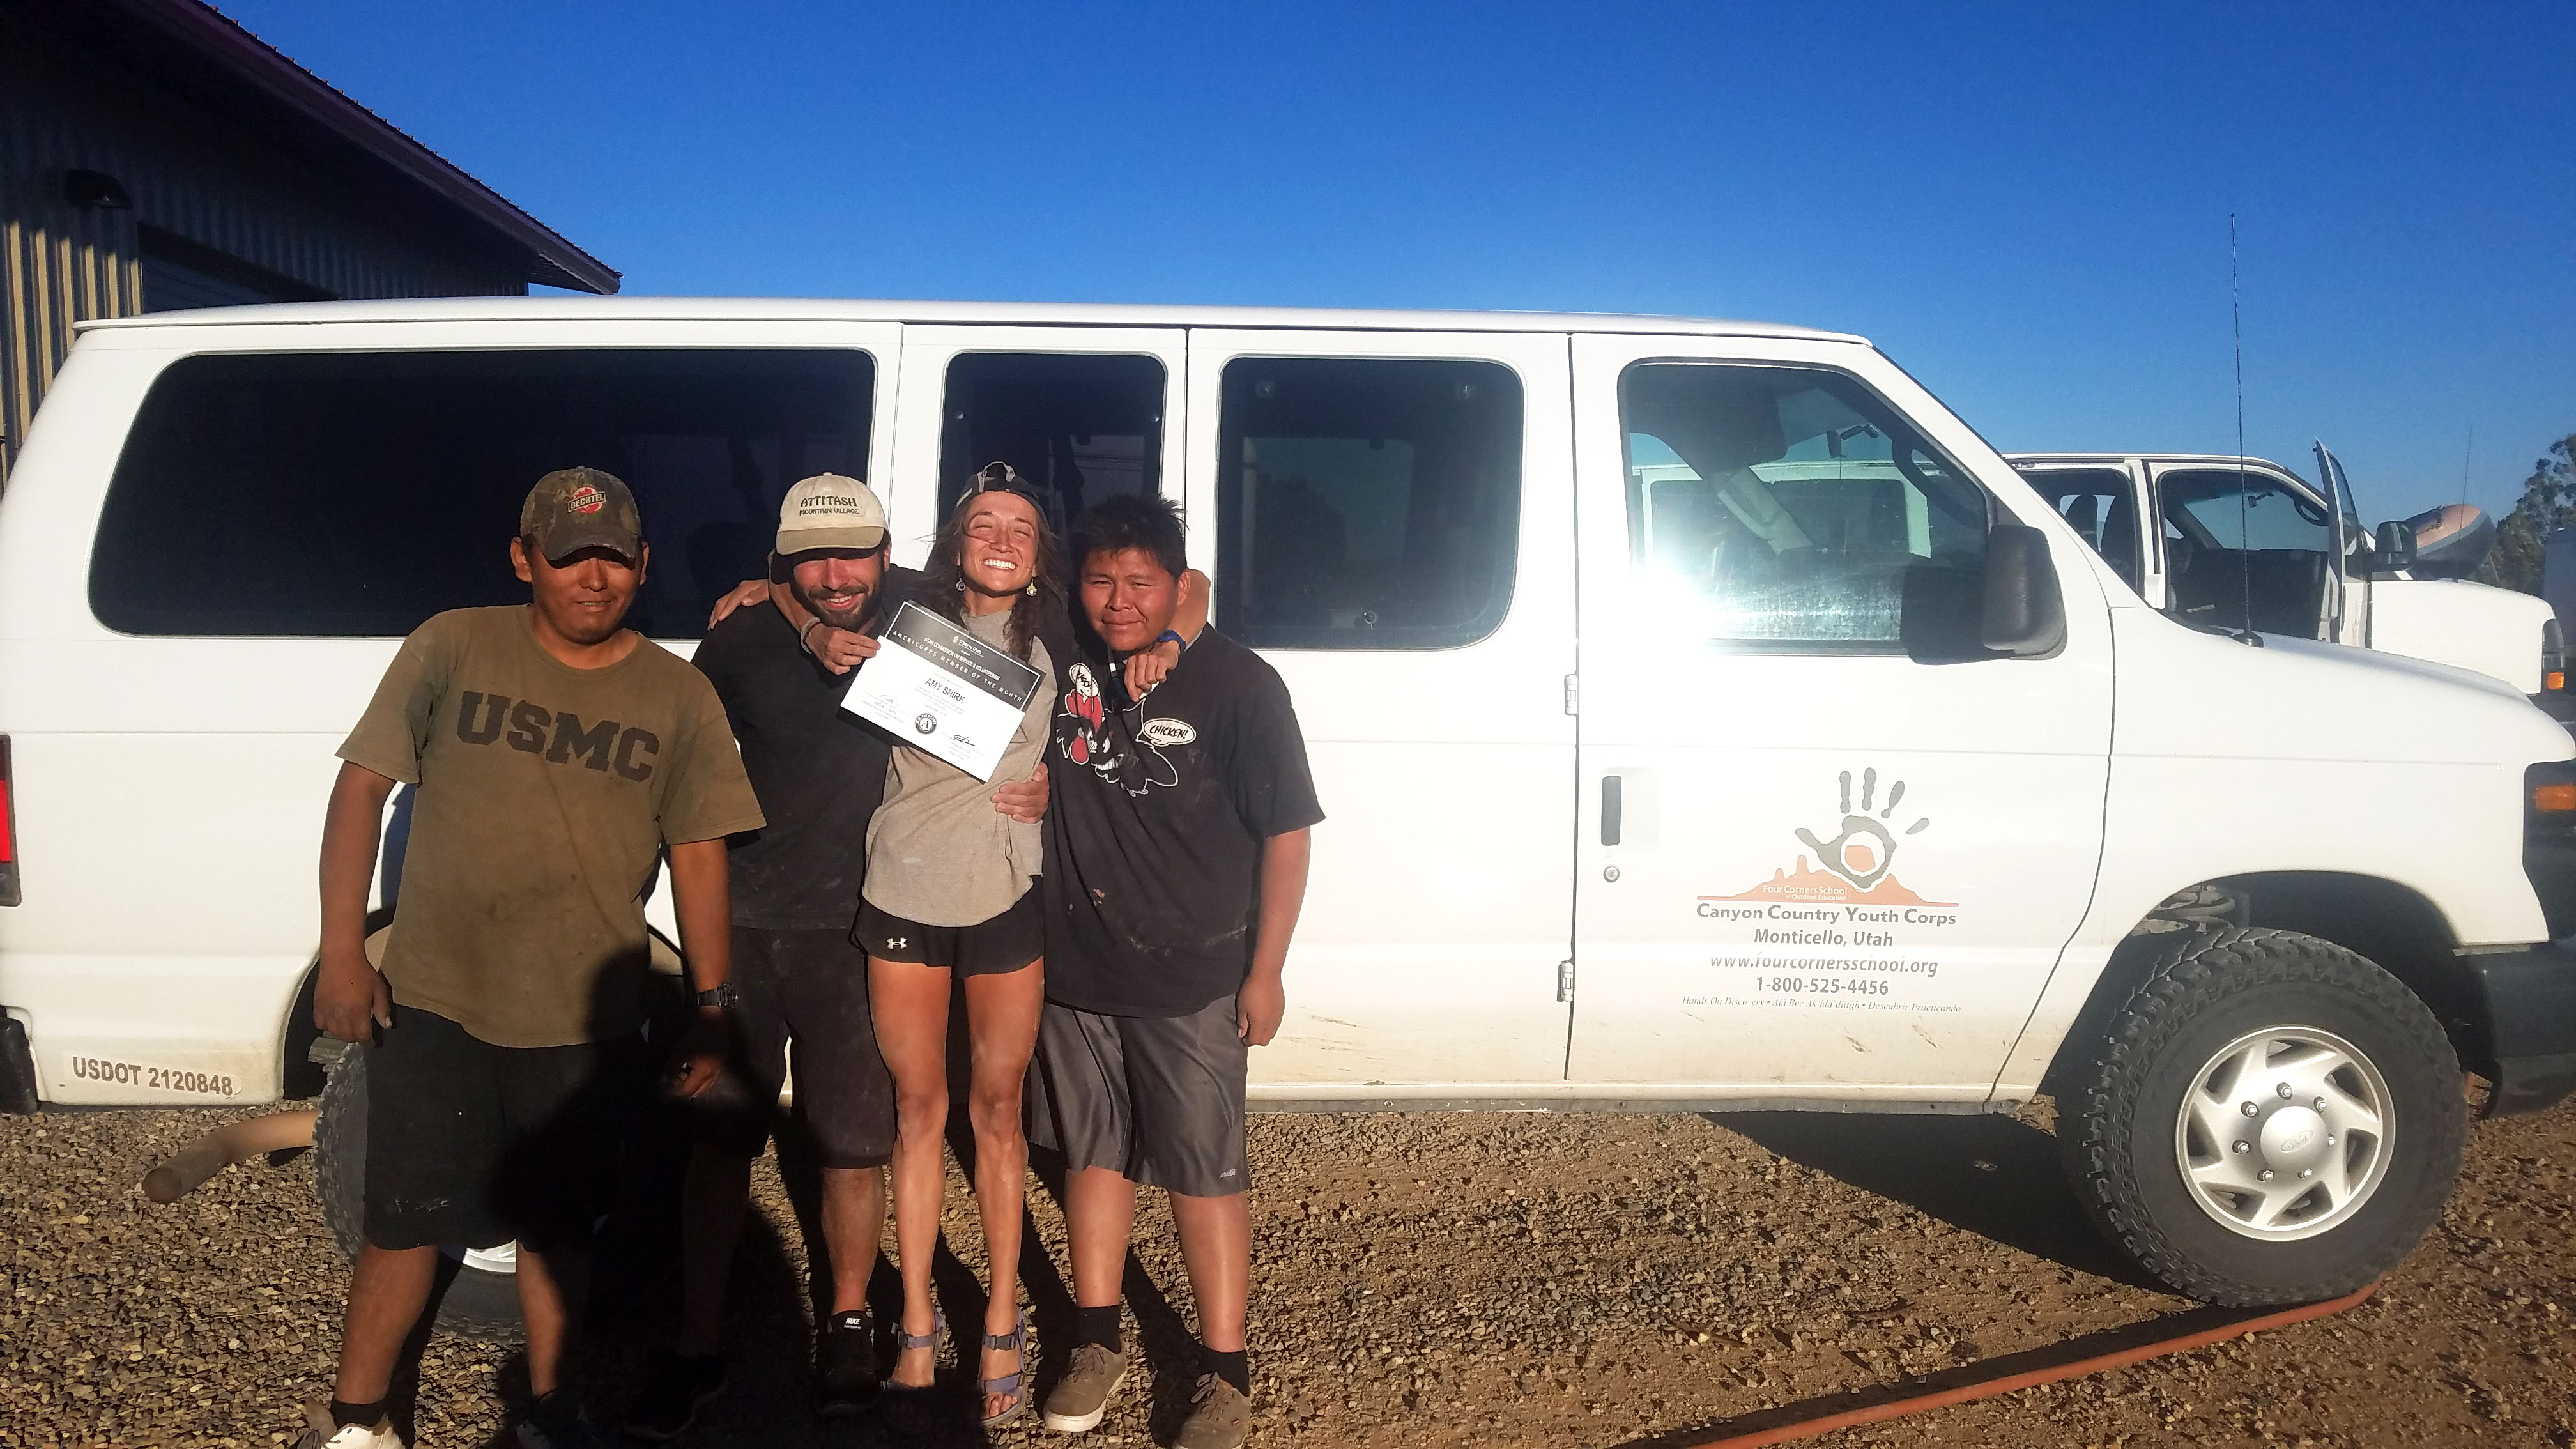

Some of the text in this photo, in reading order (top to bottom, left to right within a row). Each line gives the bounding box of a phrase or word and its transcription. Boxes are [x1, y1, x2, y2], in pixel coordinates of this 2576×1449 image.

[571, 494, 604, 509] BECHTEL
[801, 496, 857, 507] ATTITASH
[933, 642, 954, 657] COMMISSION
[959, 656, 974, 668] SERVICE
[893, 630, 937, 657] AMERICORPS
[940, 656, 969, 674] MEMBER
[984, 678, 995, 689] THE
[999, 687, 1022, 703] MONTH
[925, 678, 943, 691] AMY
[942, 687, 965, 703] SHIRK
[457, 691, 660, 783] USMC
[1149, 725, 1188, 739] CHICKEN!
[1763, 885, 1848, 894] Four Corners School
[1696, 903, 1956, 927] Canyon Country Youth Corps
[1754, 928, 1893, 947] Monticello, Utah
[1756, 976, 1889, 995] 1-800-525-4456
[1682, 996, 1707, 1005] Hands
[1710, 997, 1722, 1005] On
[1724, 997, 1765, 1007] Discovery
[1868, 1001, 1910, 1011] Descubrir
[1911, 1002, 1961, 1013] Practicando
[72, 1056, 233, 1096] USDOT 2120848
